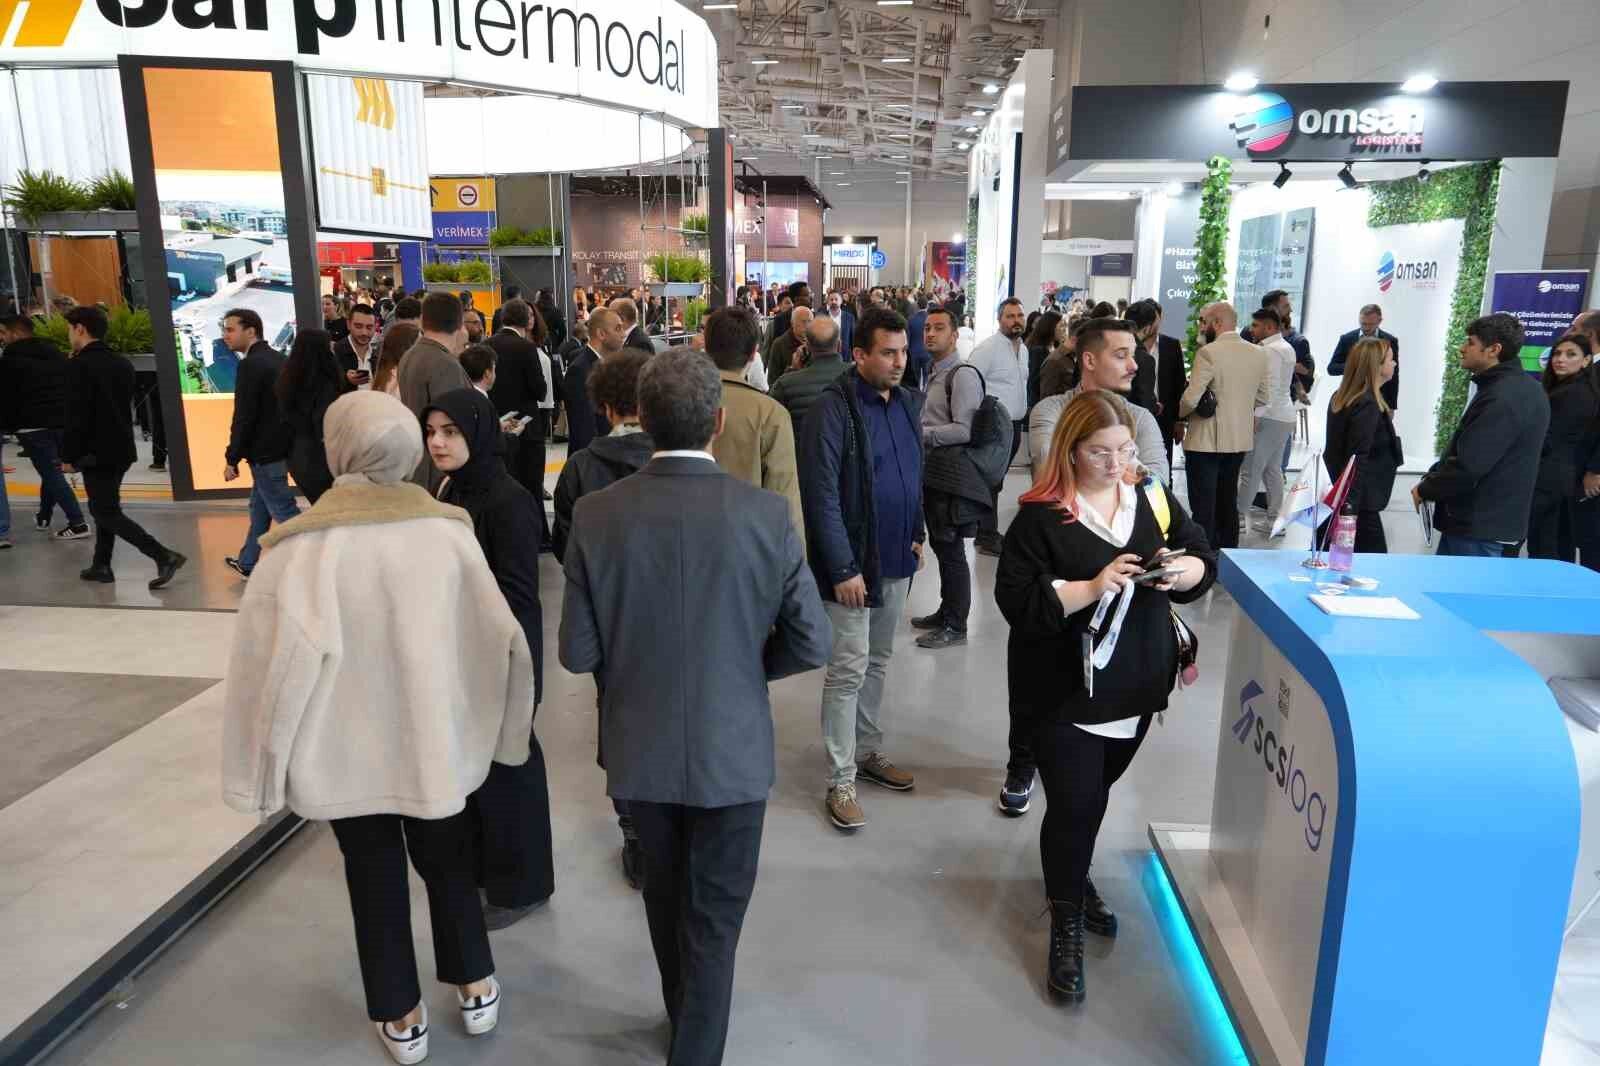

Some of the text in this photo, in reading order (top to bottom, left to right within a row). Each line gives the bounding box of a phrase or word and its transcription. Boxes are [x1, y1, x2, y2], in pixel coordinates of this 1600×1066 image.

[1298, 107, 1425, 135] omsan
[1396, 260, 1438, 280] omsan
[1253, 715, 1327, 853] scslog
